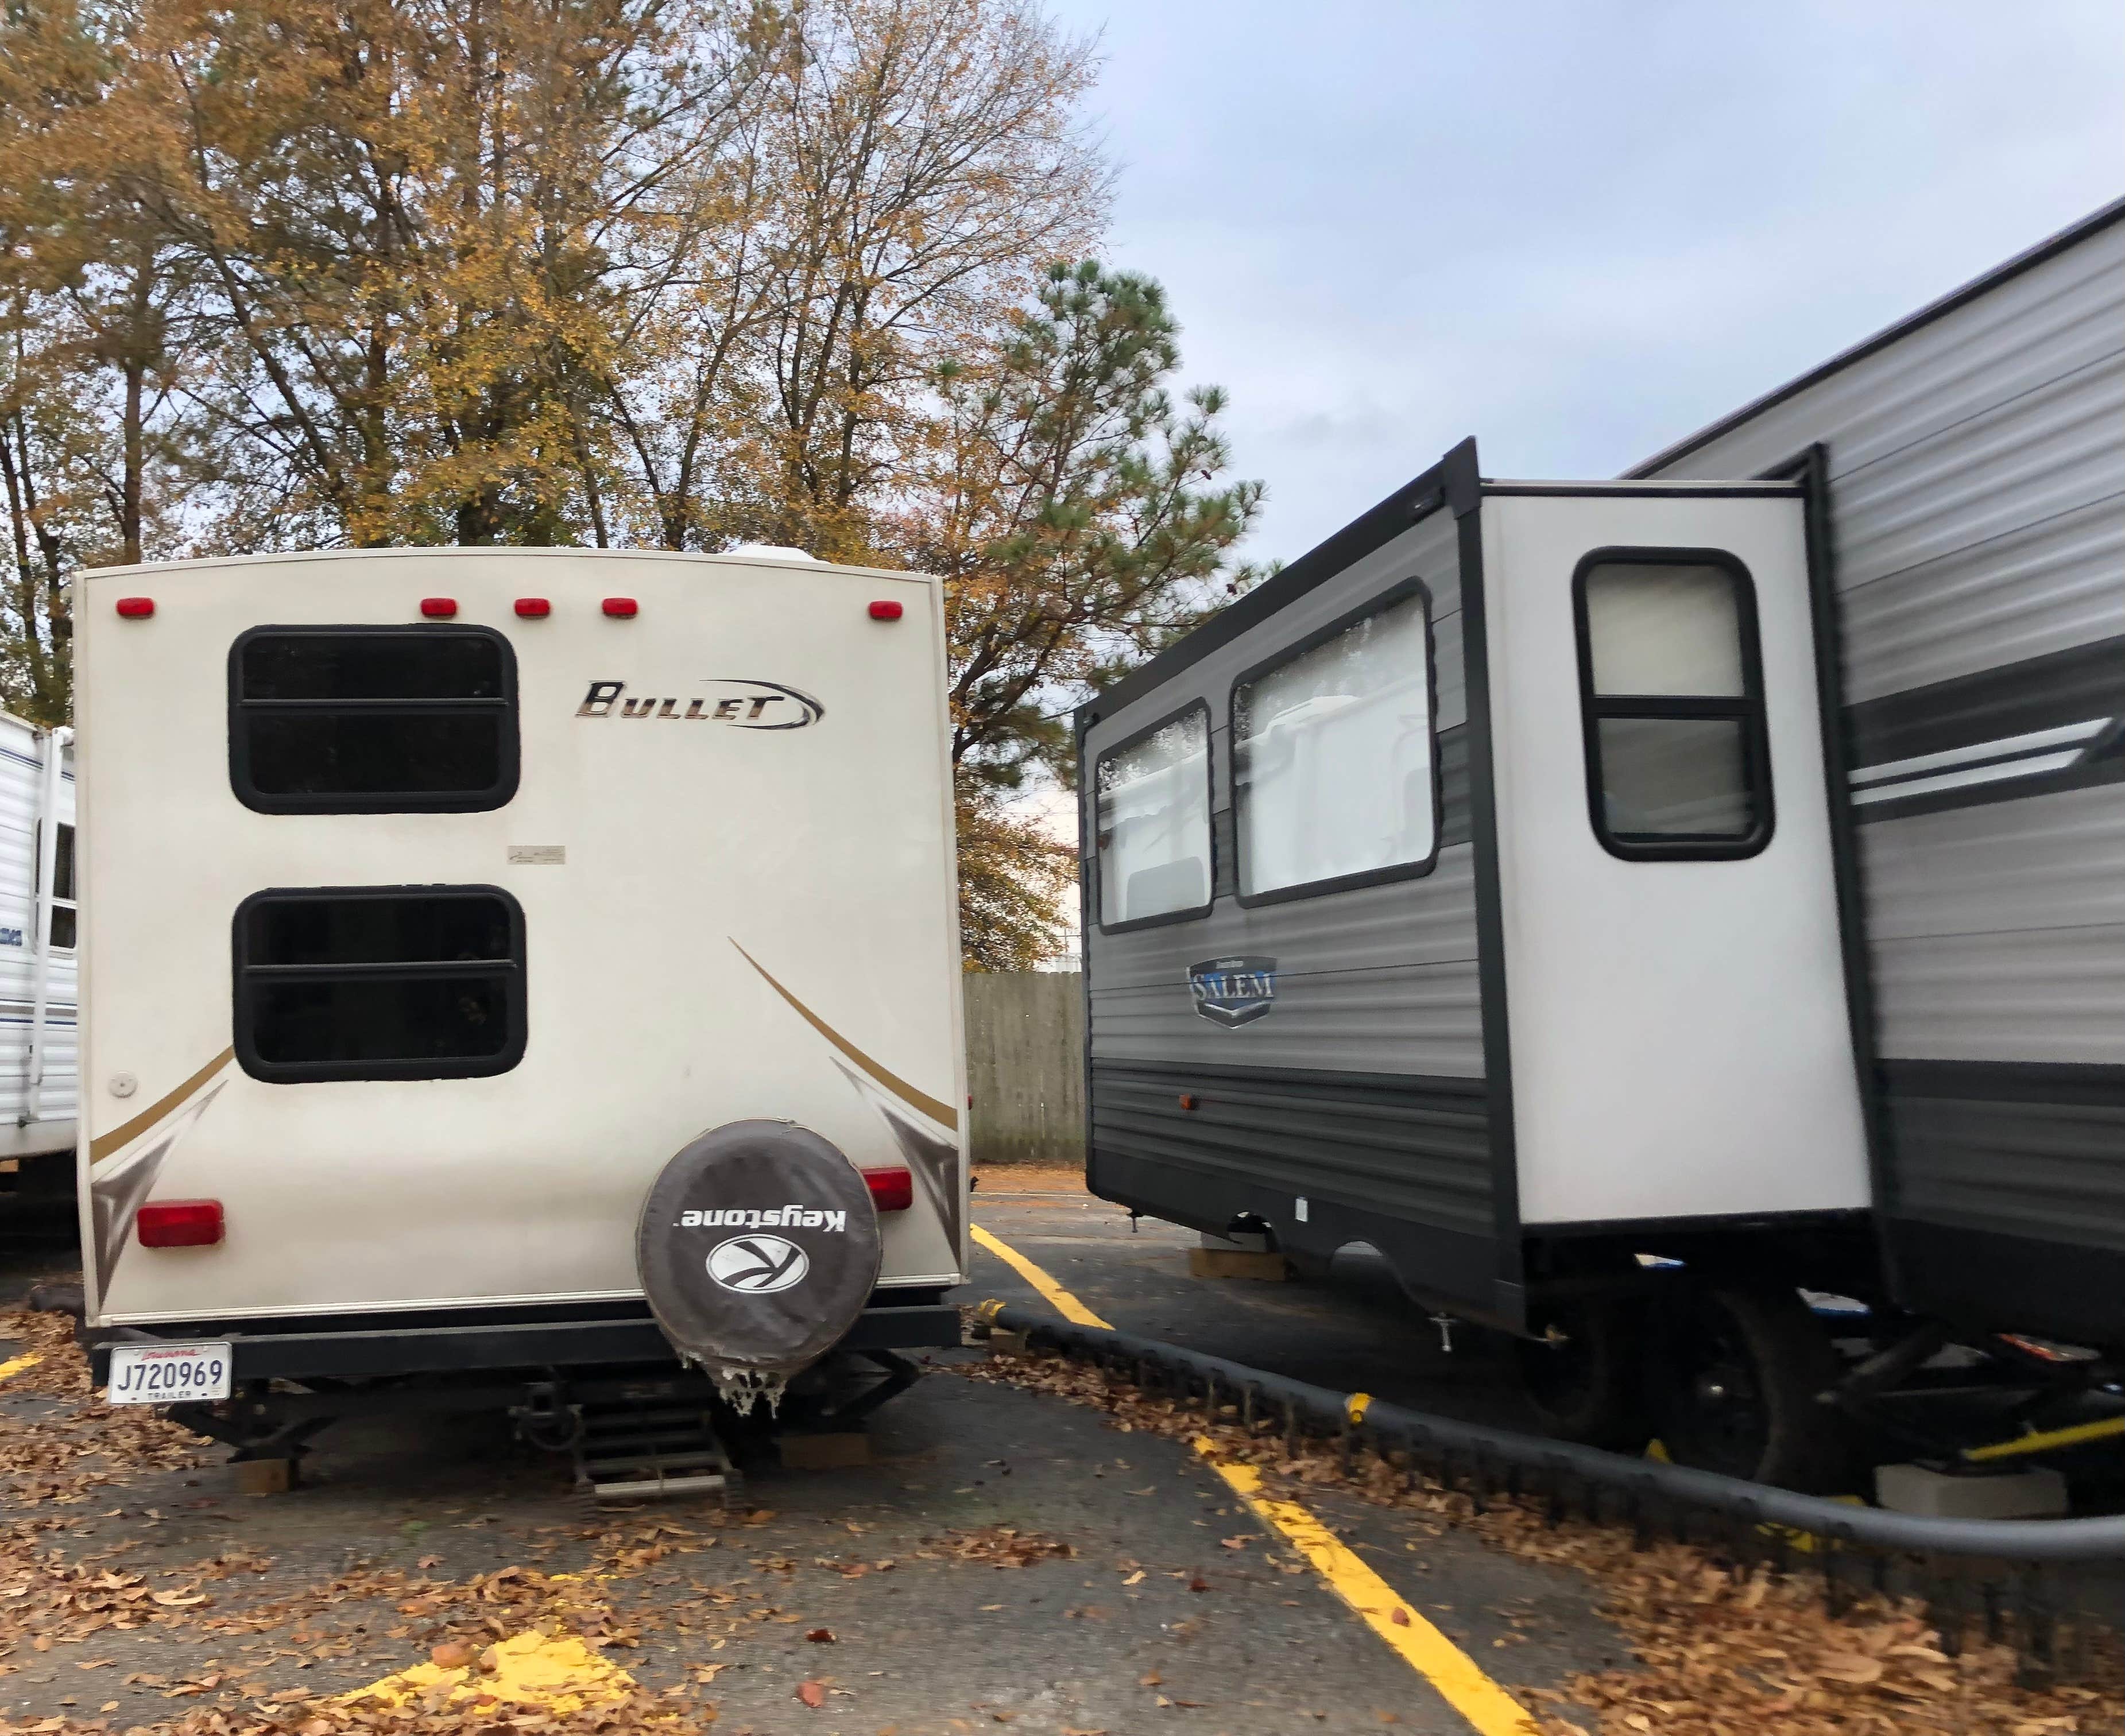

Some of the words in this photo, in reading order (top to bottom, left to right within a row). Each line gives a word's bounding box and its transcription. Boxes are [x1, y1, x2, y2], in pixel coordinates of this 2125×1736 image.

[575, 680, 784, 719] BULLET
[1194, 972, 1274, 1001] SALEM
[681, 1204, 846, 1232] Keystone
[118, 1359, 222, 1390] J720969
